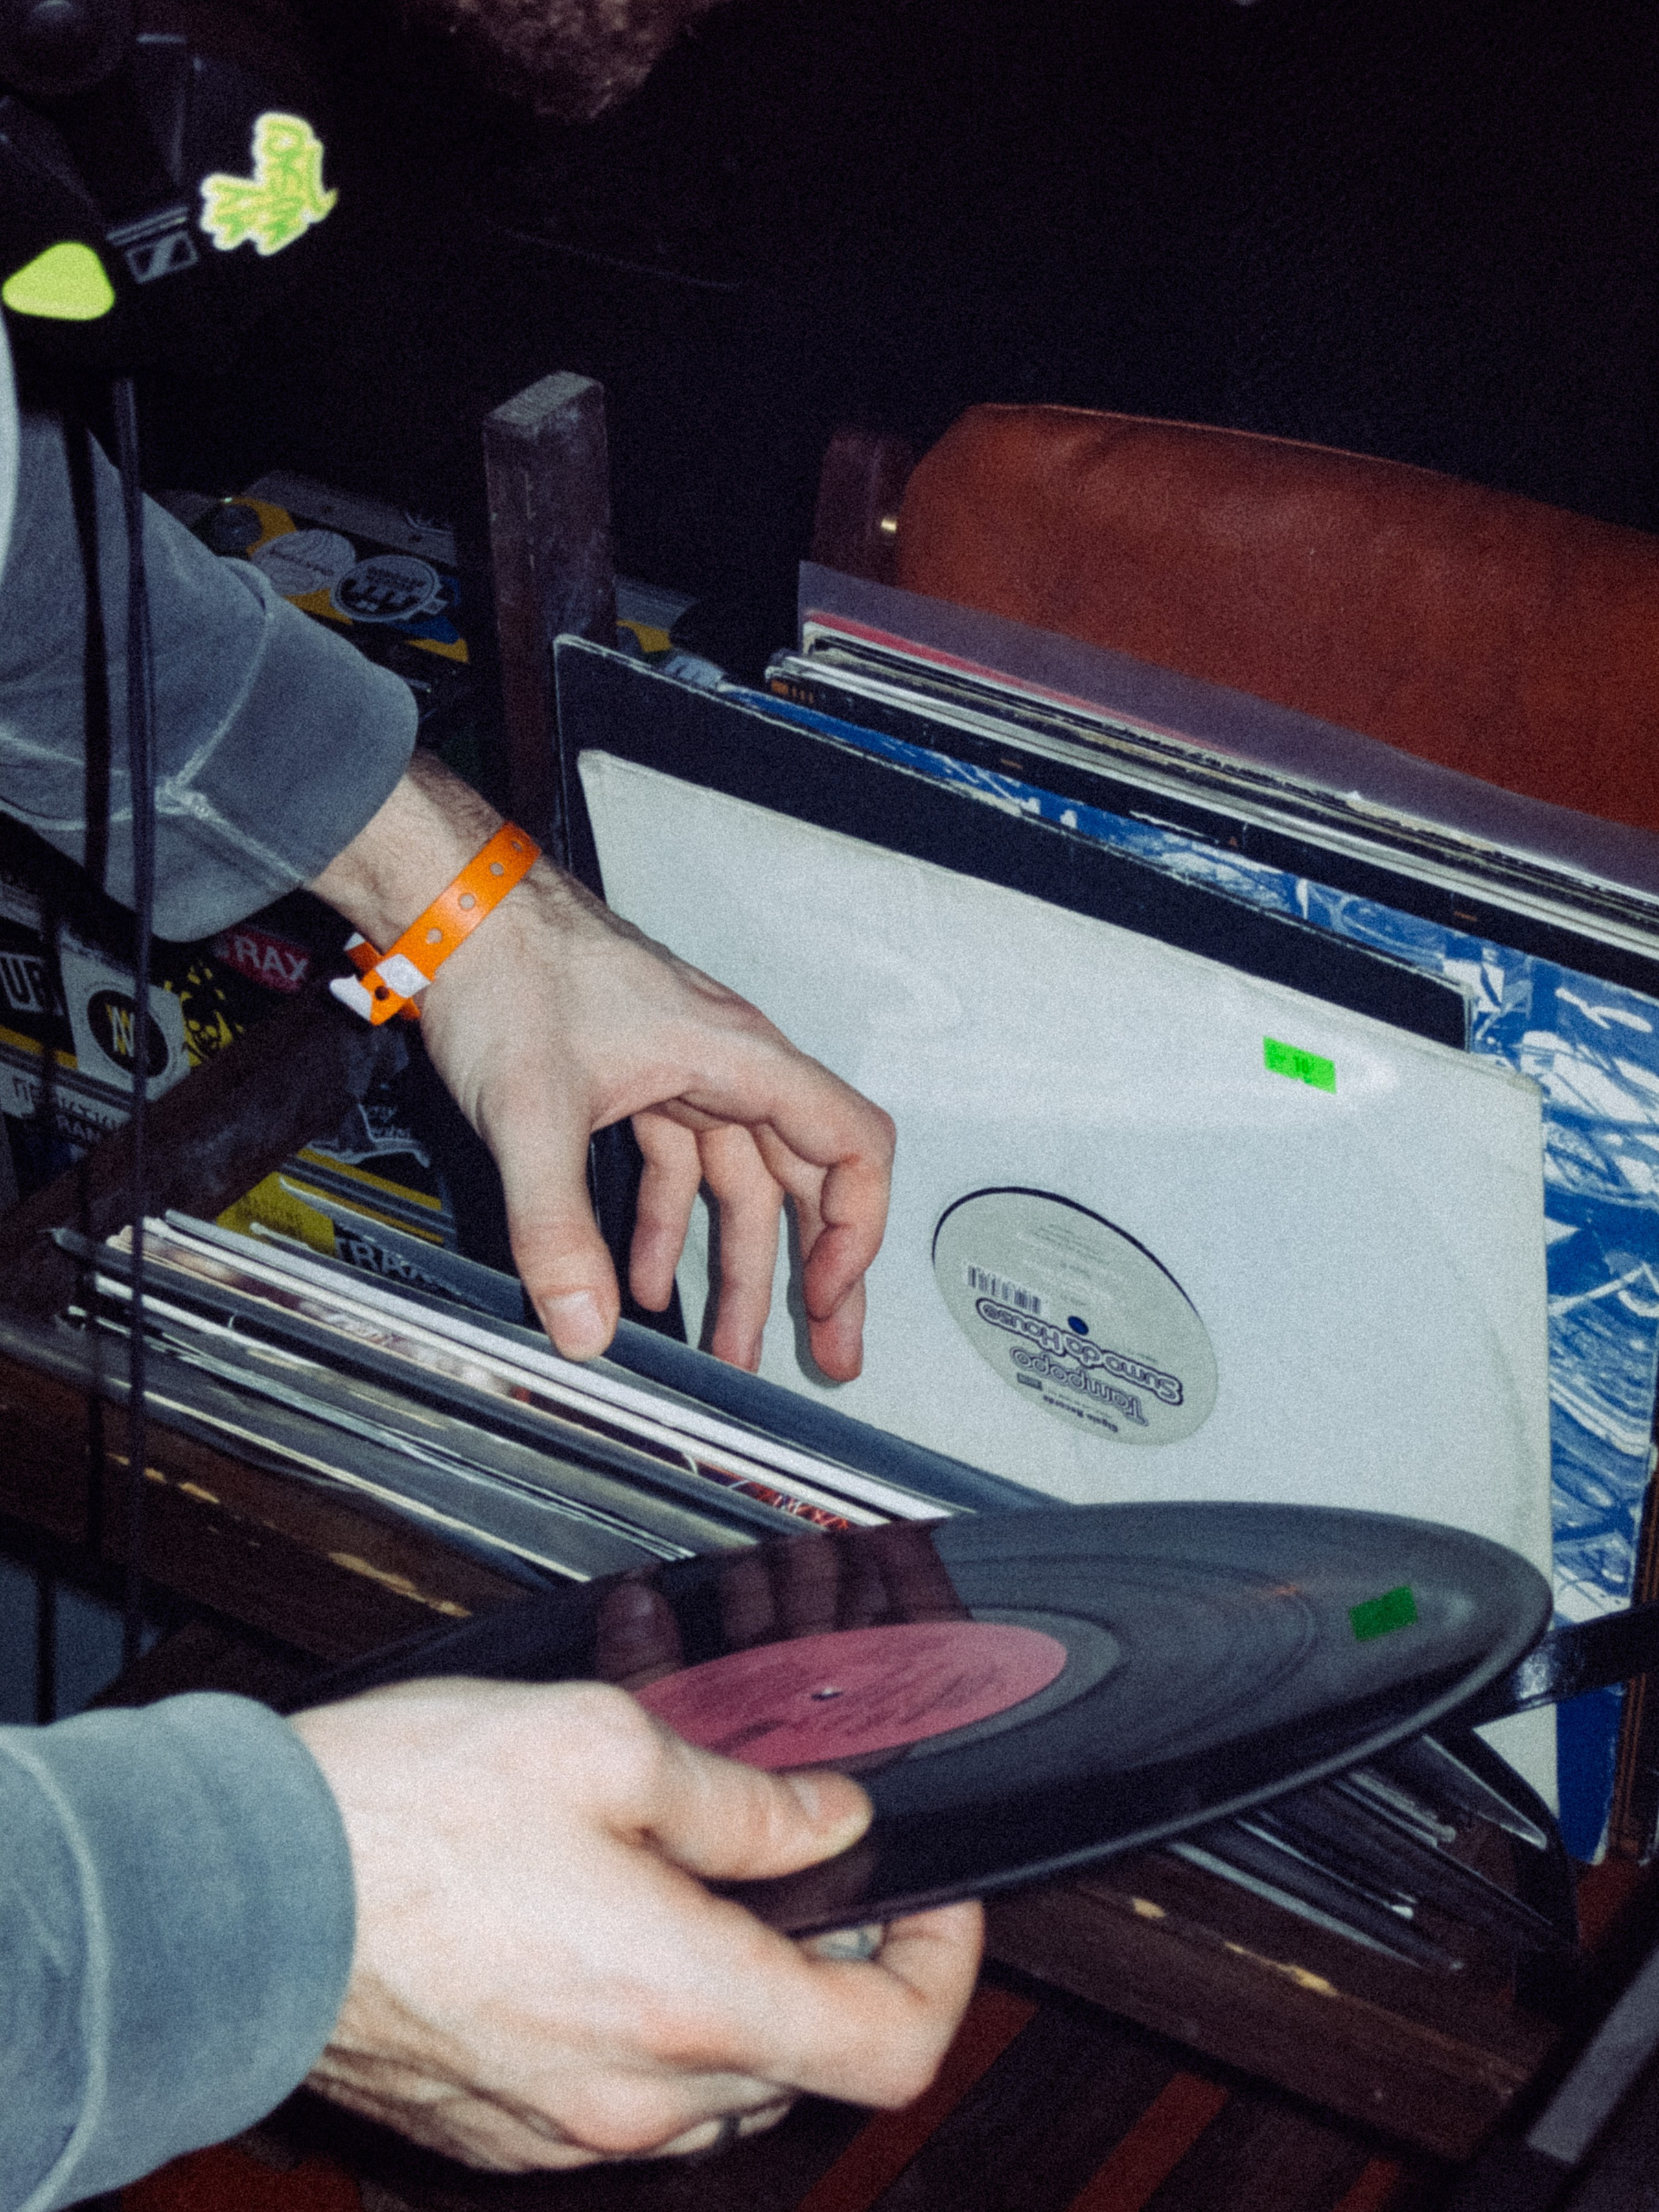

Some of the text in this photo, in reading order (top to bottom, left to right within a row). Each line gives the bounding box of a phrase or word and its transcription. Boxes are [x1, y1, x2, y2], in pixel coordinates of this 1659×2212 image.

[976, 1298, 1067, 1357] House
[1010, 1346, 1148, 1426] Tampopo
[1043, 1395, 1084, 1417] Records
[1103, 1350, 1183, 1406] Sumo
